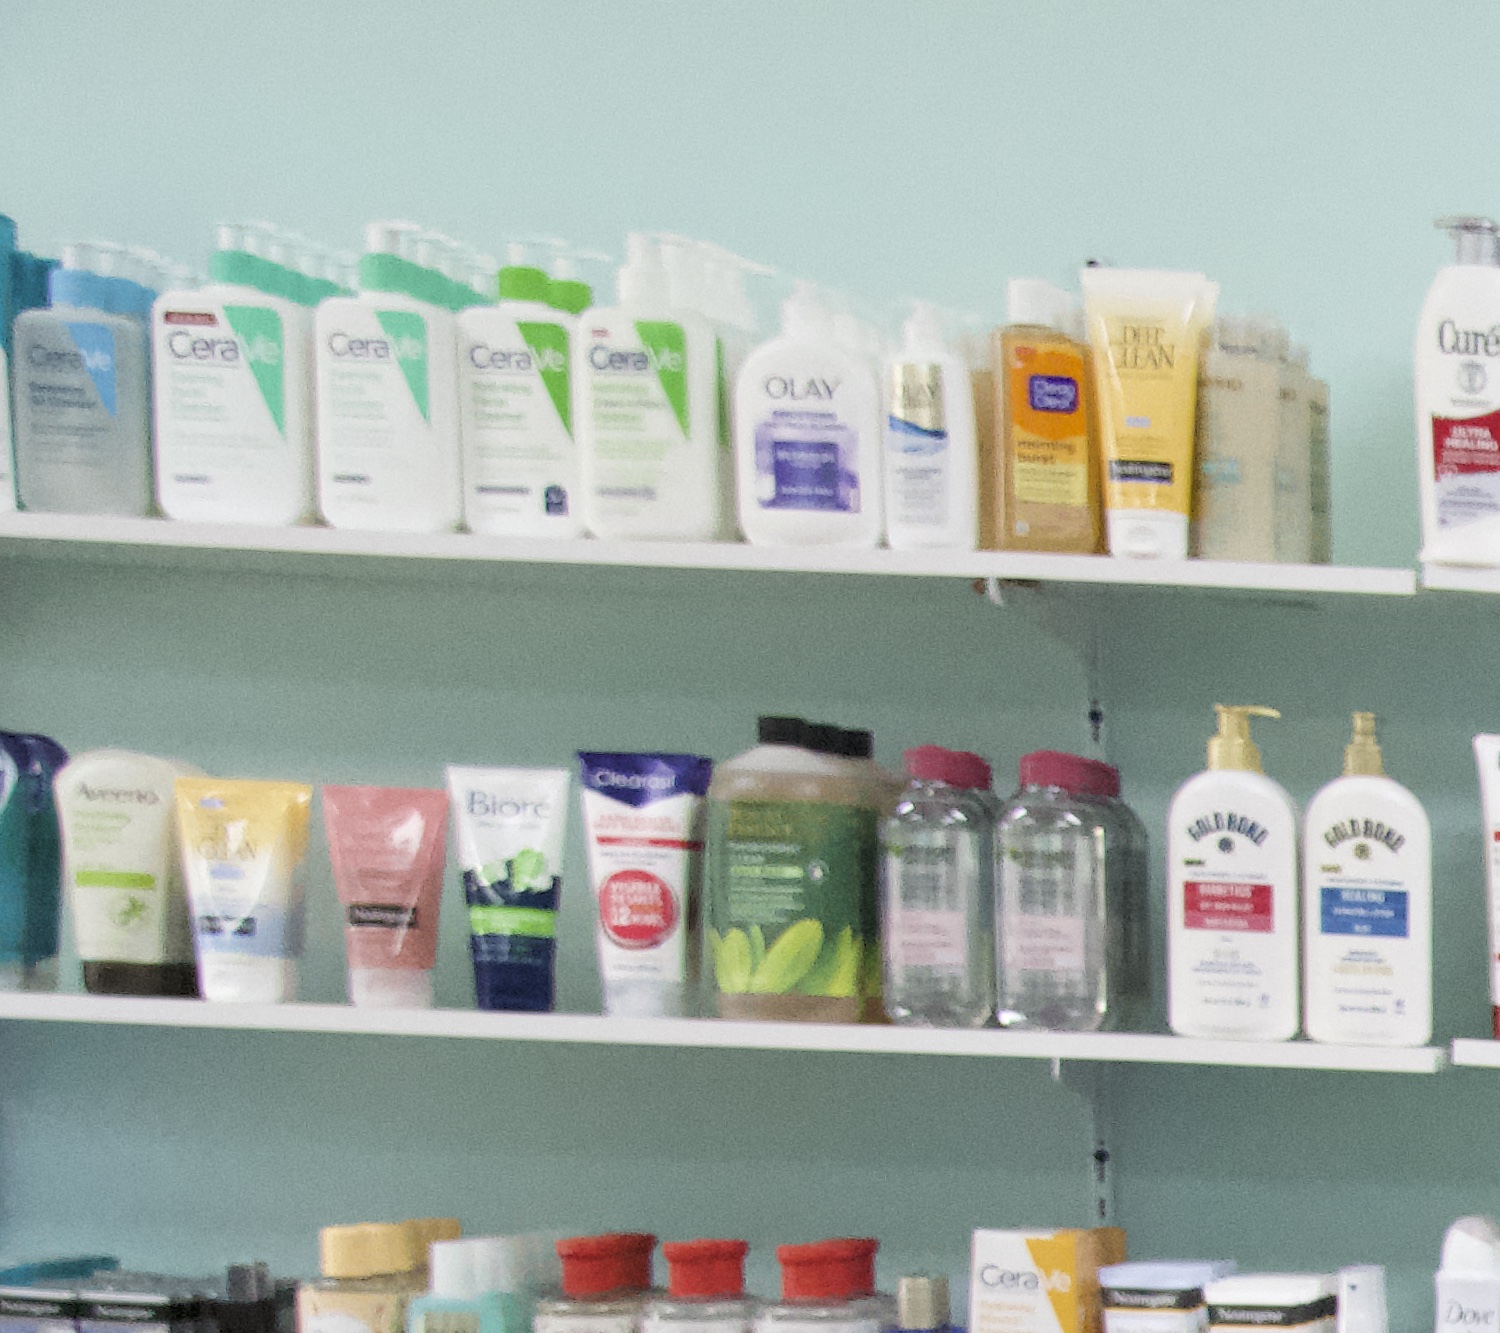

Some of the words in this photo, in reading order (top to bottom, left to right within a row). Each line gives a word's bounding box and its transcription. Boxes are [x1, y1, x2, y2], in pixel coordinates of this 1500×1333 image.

[168, 332, 280, 364] CeraVe
[328, 332, 423, 363] CeraVe
[470, 343, 565, 373] CeraVe
[589, 343, 682, 373] CeraVe
[765, 376, 844, 402] OLAY
[979, 1264, 1071, 1292] CeraVe
[1446, 1301, 1494, 1326] Dove
